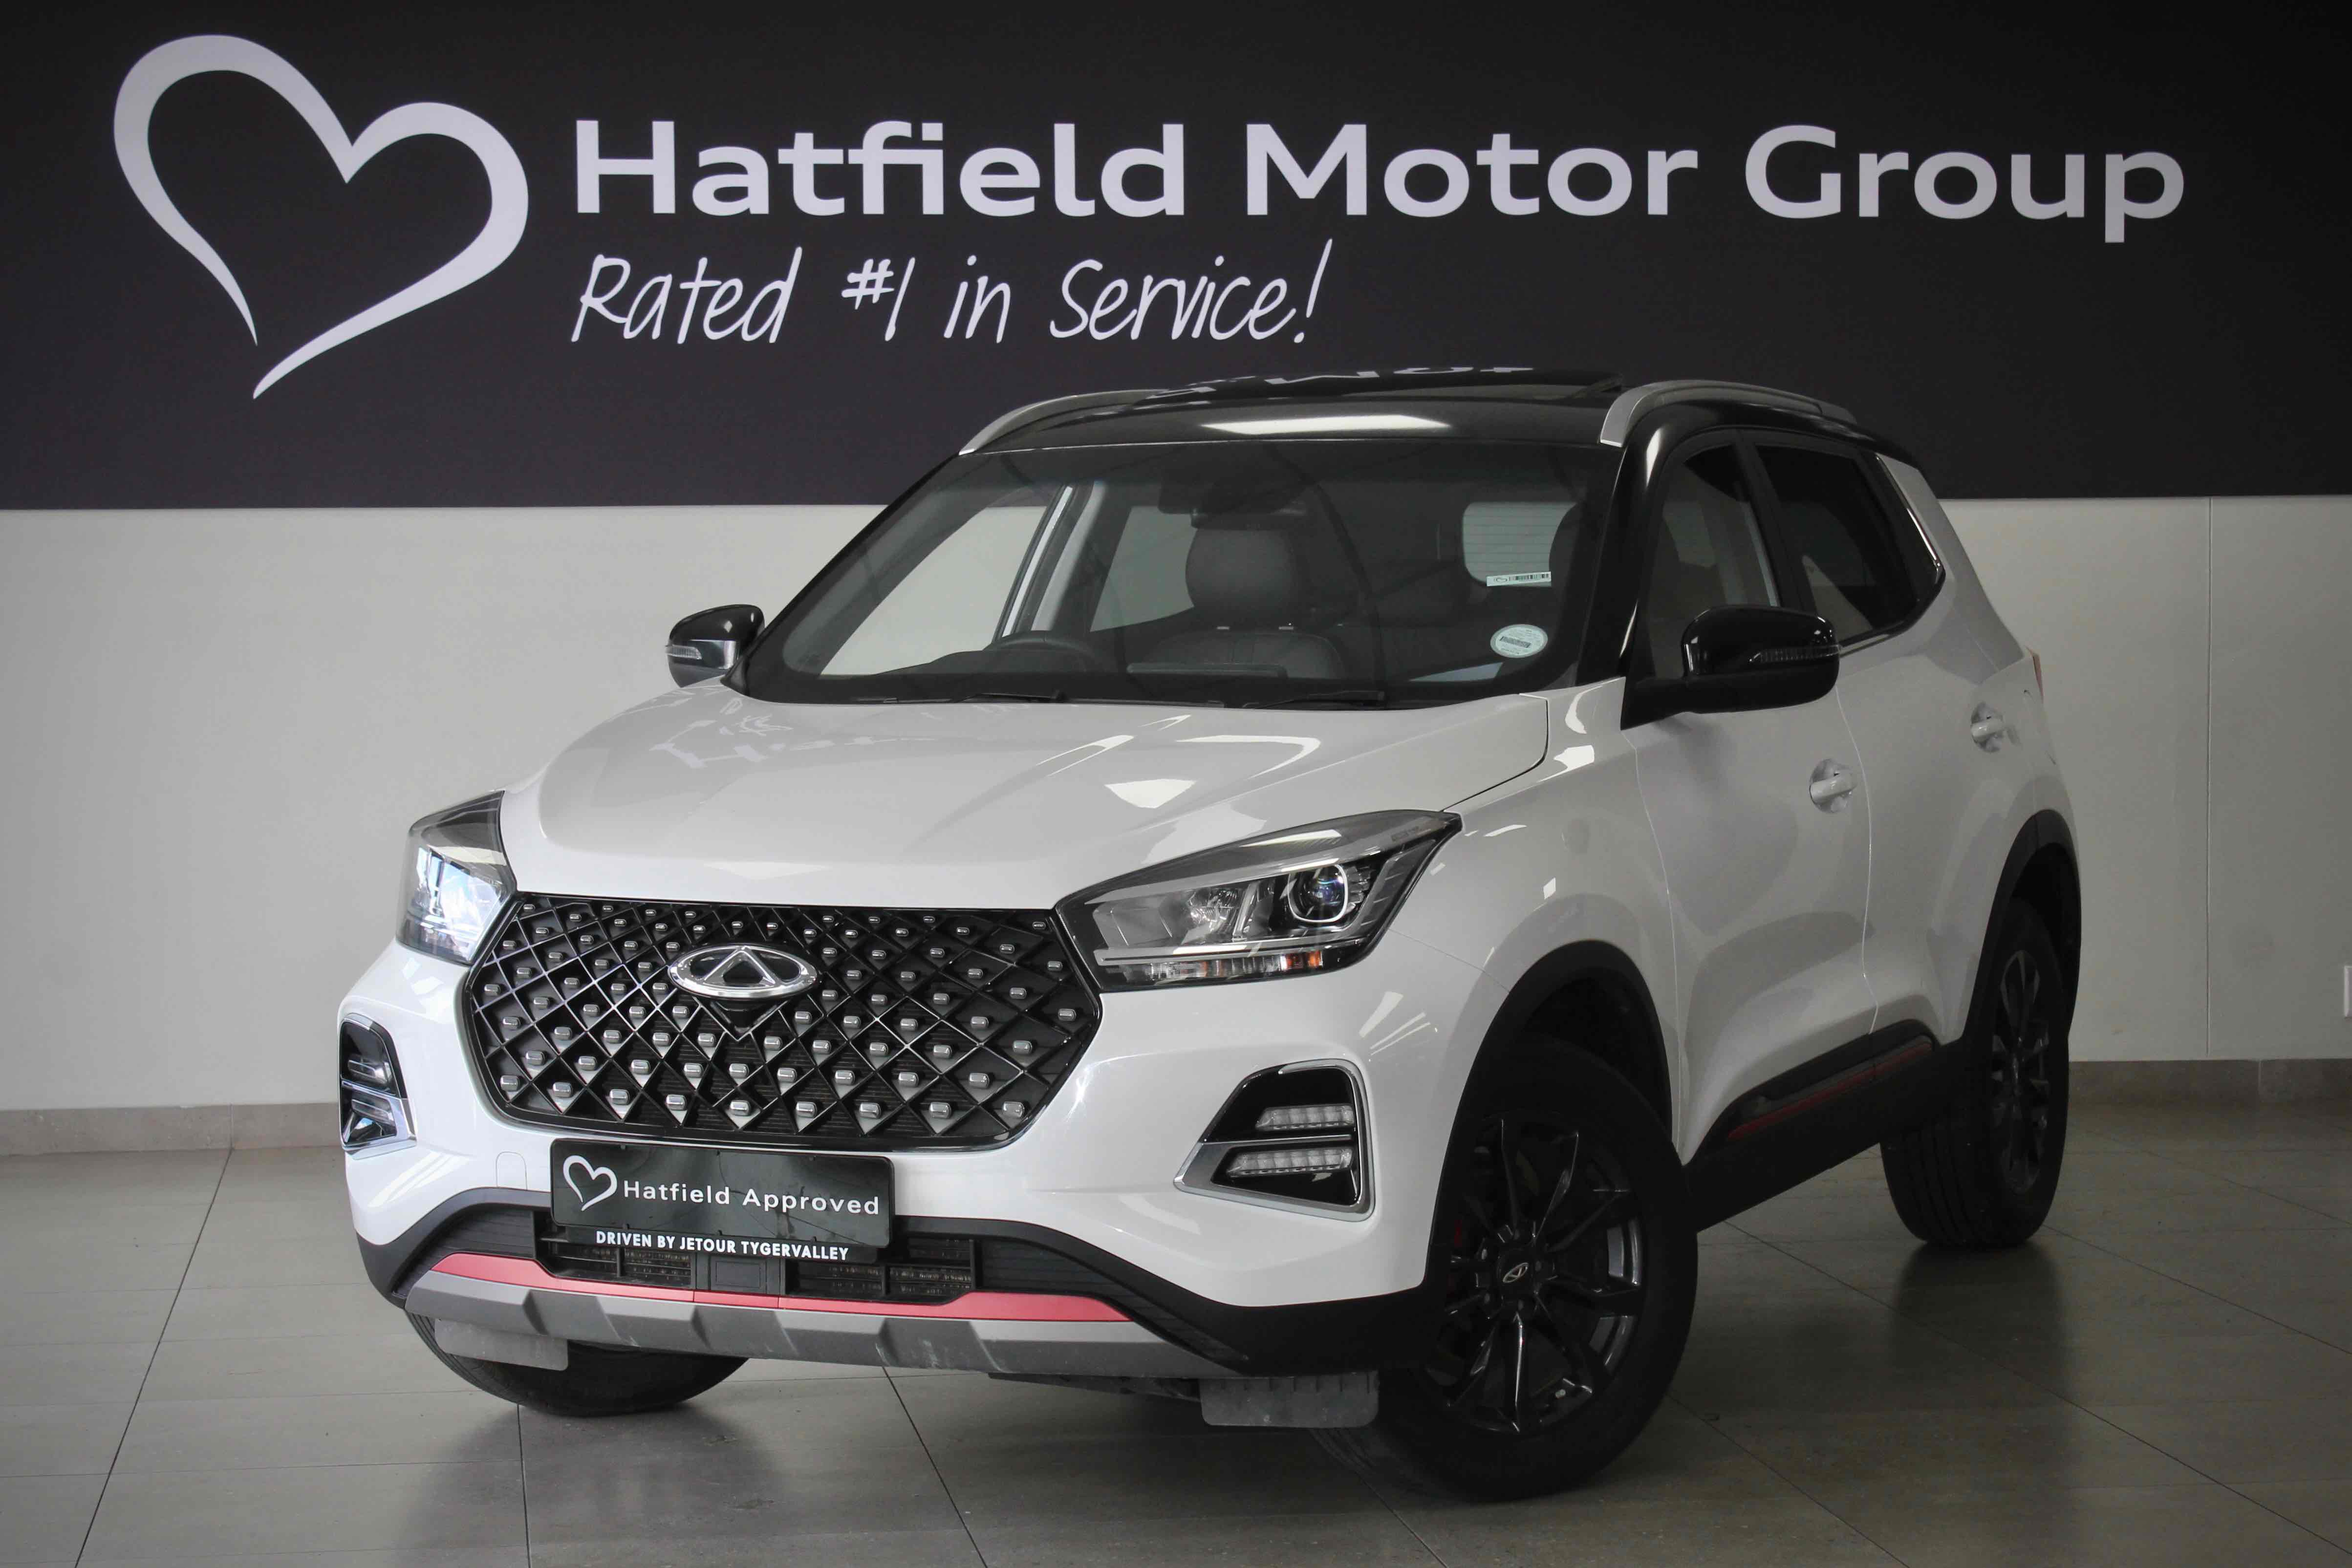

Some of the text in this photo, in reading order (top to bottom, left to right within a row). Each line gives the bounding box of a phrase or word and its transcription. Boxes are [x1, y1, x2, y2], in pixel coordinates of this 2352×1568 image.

[576, 119, 2183, 243] Hatfield Motor Group
[571, 237, 1333, 345] Rated #1 in Service!
[624, 1180, 879, 1215] Hatfield Approved
[596, 1230, 849, 1261] DRIVEN BY JETOUR TYGERVALLEY
